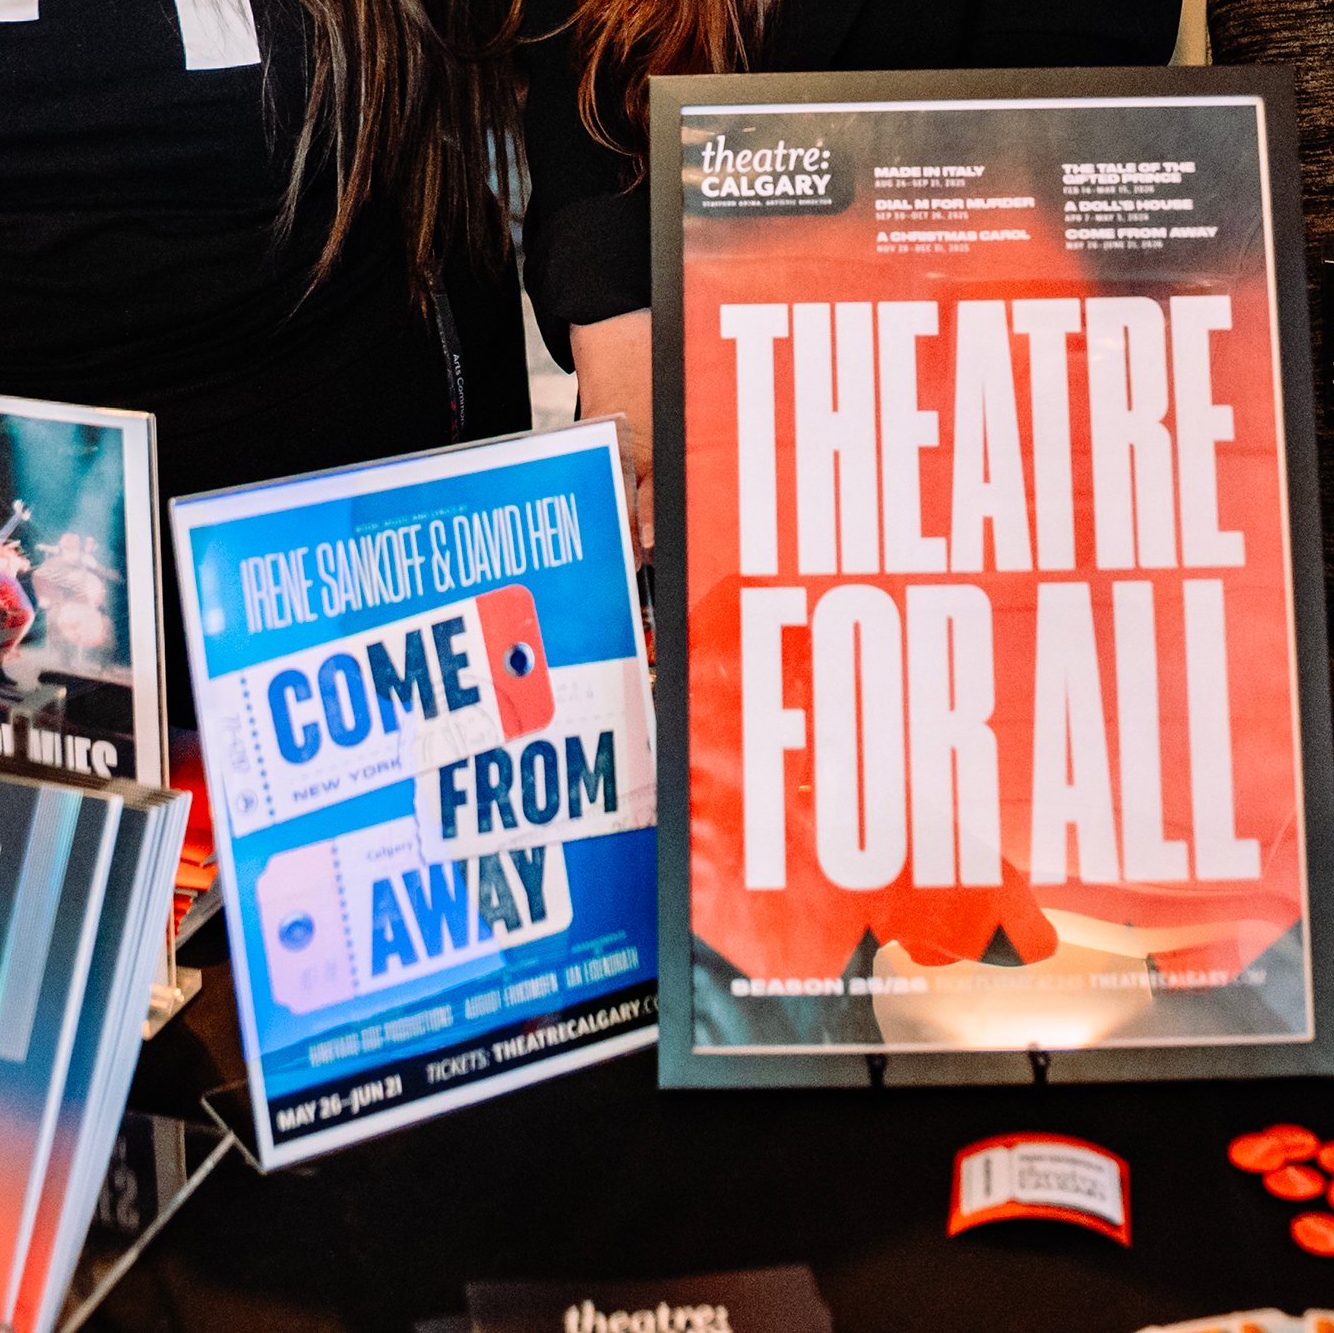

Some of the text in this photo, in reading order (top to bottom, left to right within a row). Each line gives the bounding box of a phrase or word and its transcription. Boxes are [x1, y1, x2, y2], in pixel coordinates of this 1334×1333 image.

[702, 135, 831, 174] theatre:
[874, 166, 985, 178] MADE IN ITALY
[701, 174, 832, 198] CALGARY
[875, 197, 1035, 210] DIAL M FOR MURDER
[877, 232, 888, 242] A
[720, 296, 1246, 577] THEATRE
[240, 492, 584, 636] IRENE SANKOFF & DAVID HEIN
[267, 616, 482, 765] COME
[740, 580, 1262, 891] FOR ALL
[293, 757, 402, 802] NEW YORK
[438, 730, 619, 843] FROM
[366, 840, 415, 862] Calgary
[370, 844, 548, 978] AWAY
[730, 977, 845, 997] SEASON
[276, 1099, 317, 1133] MAY
[384, 1073, 403, 1100] 21
